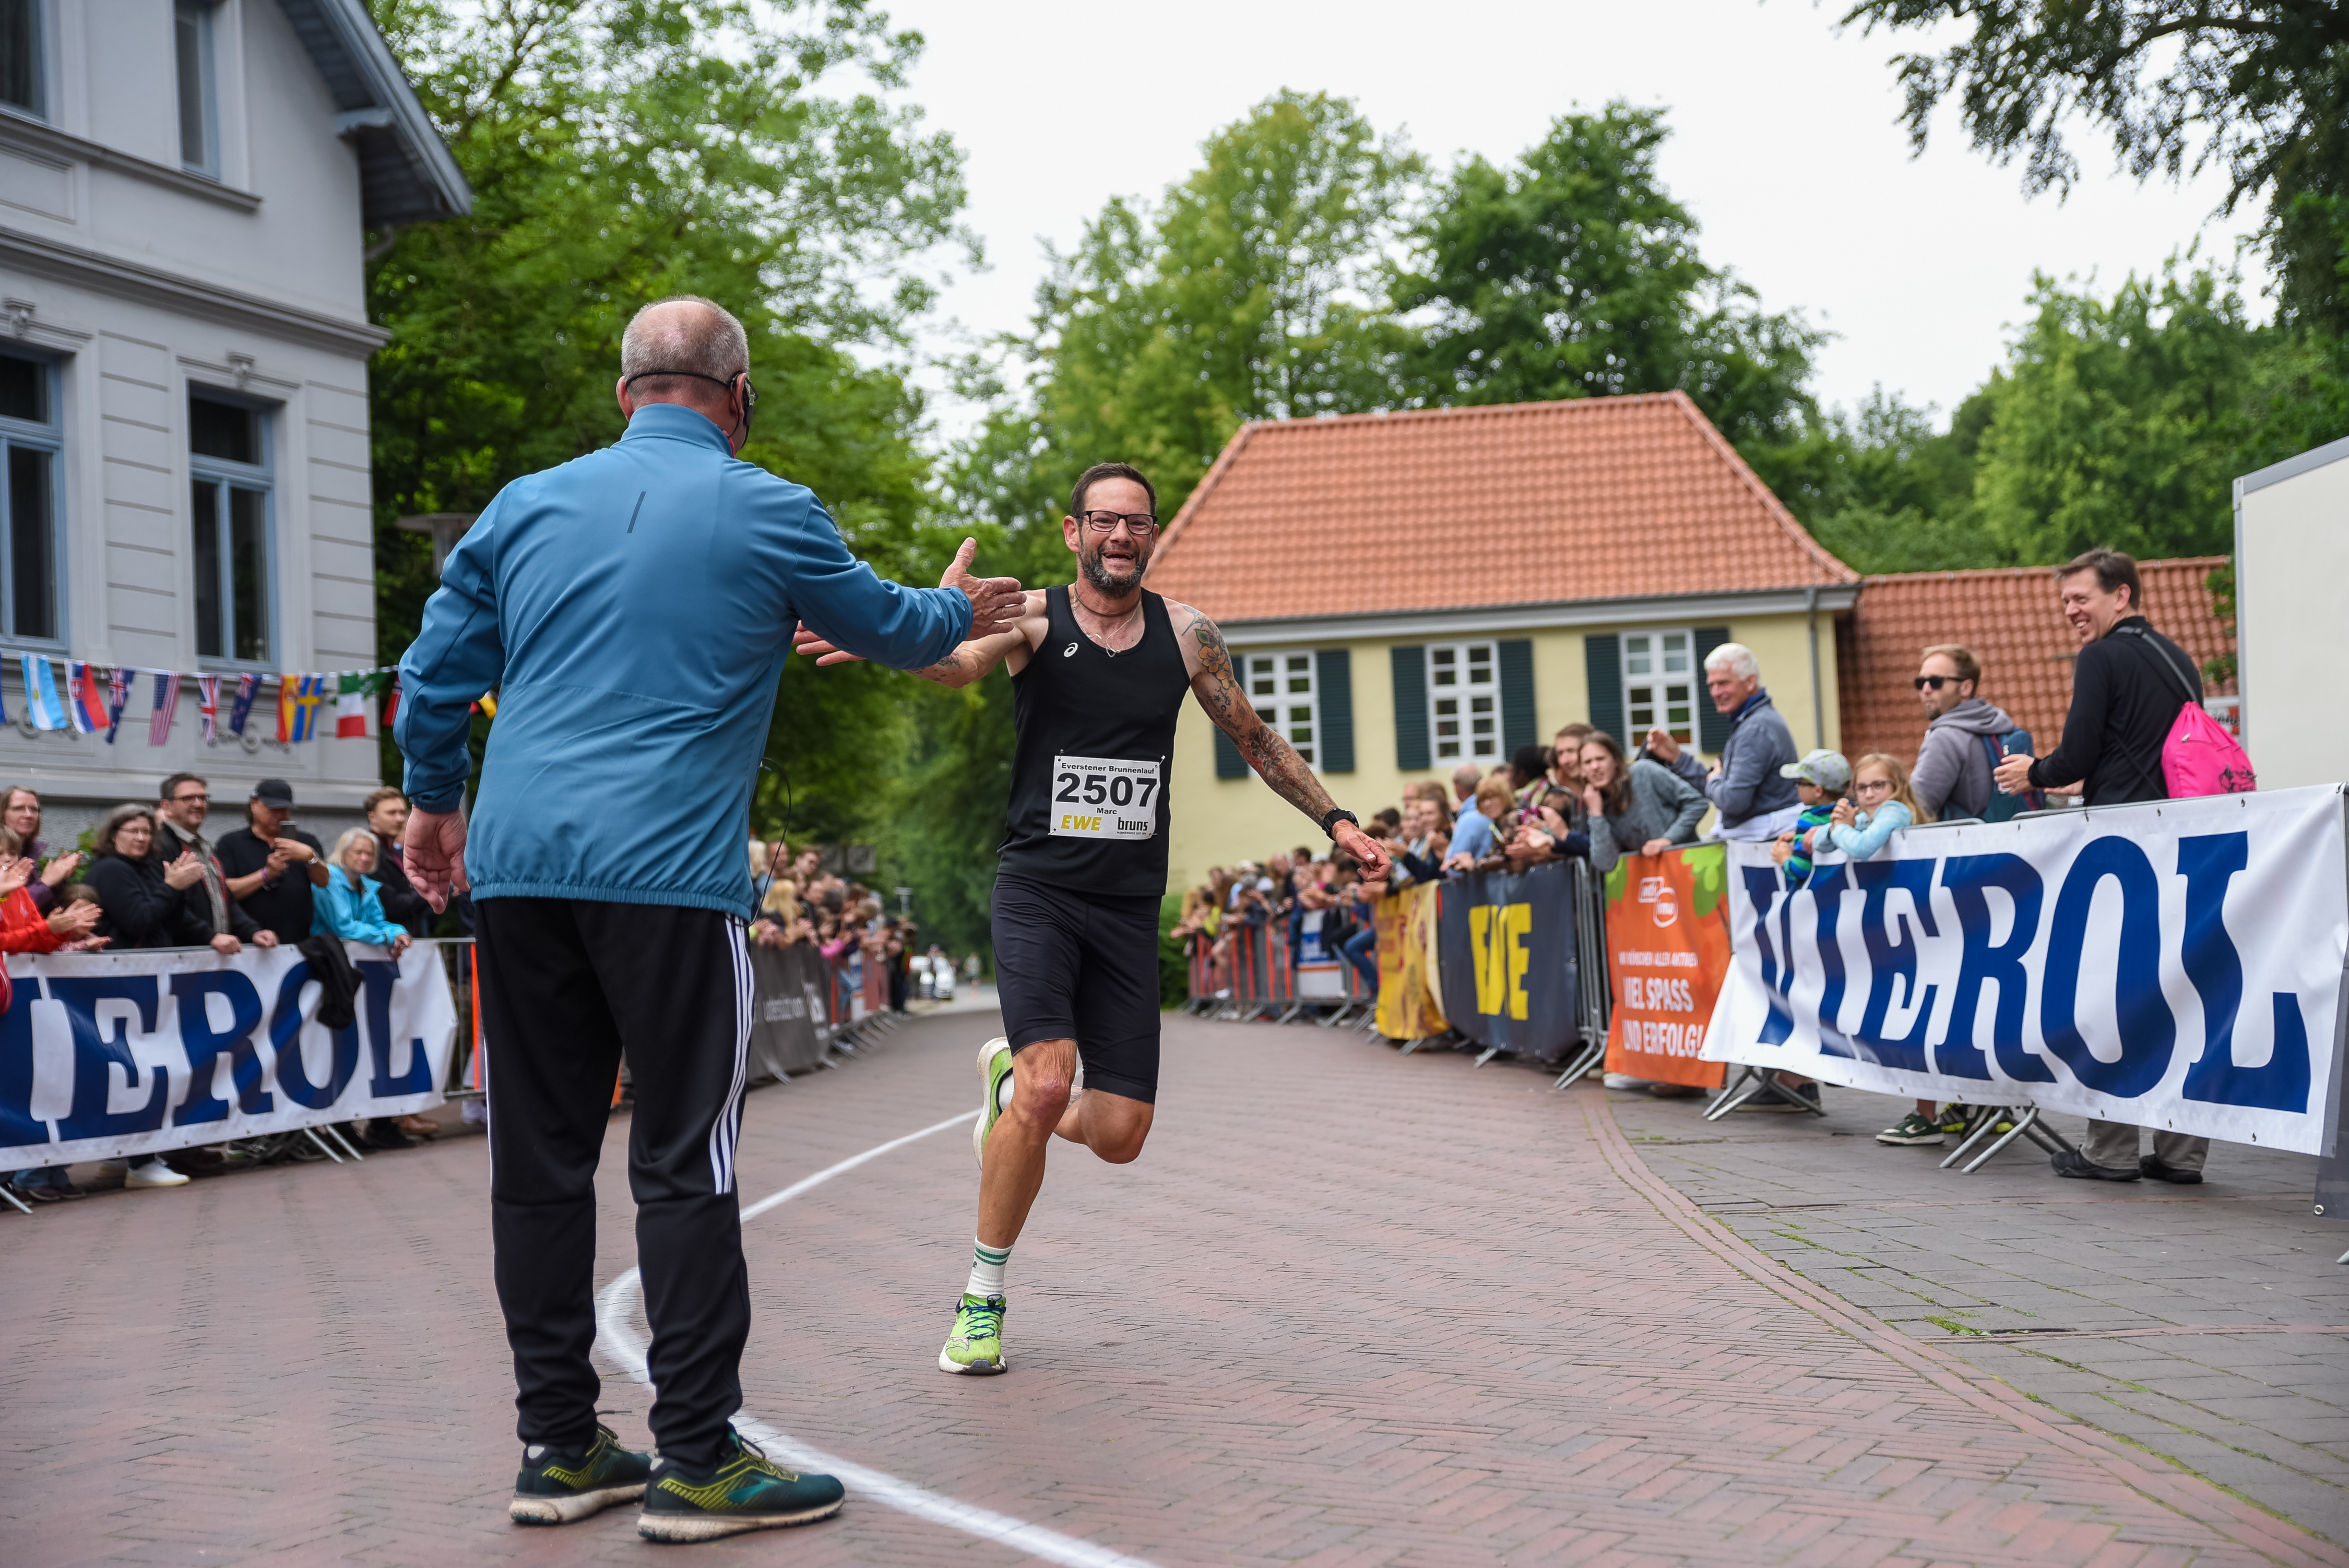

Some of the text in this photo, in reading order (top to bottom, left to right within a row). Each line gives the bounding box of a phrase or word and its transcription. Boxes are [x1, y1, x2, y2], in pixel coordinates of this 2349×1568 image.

[1061, 763, 1155, 775] Everstener Brunnenlauf
[1054, 772, 1158, 807] 2507
[1061, 815, 1102, 831] EWE
[1117, 816, 1148, 831] bruns
[1741, 830, 2311, 1114] VIEROL
[1646, 977, 1694, 1013] SPASS
[1643, 1020, 1704, 1058] ERFOLG!
